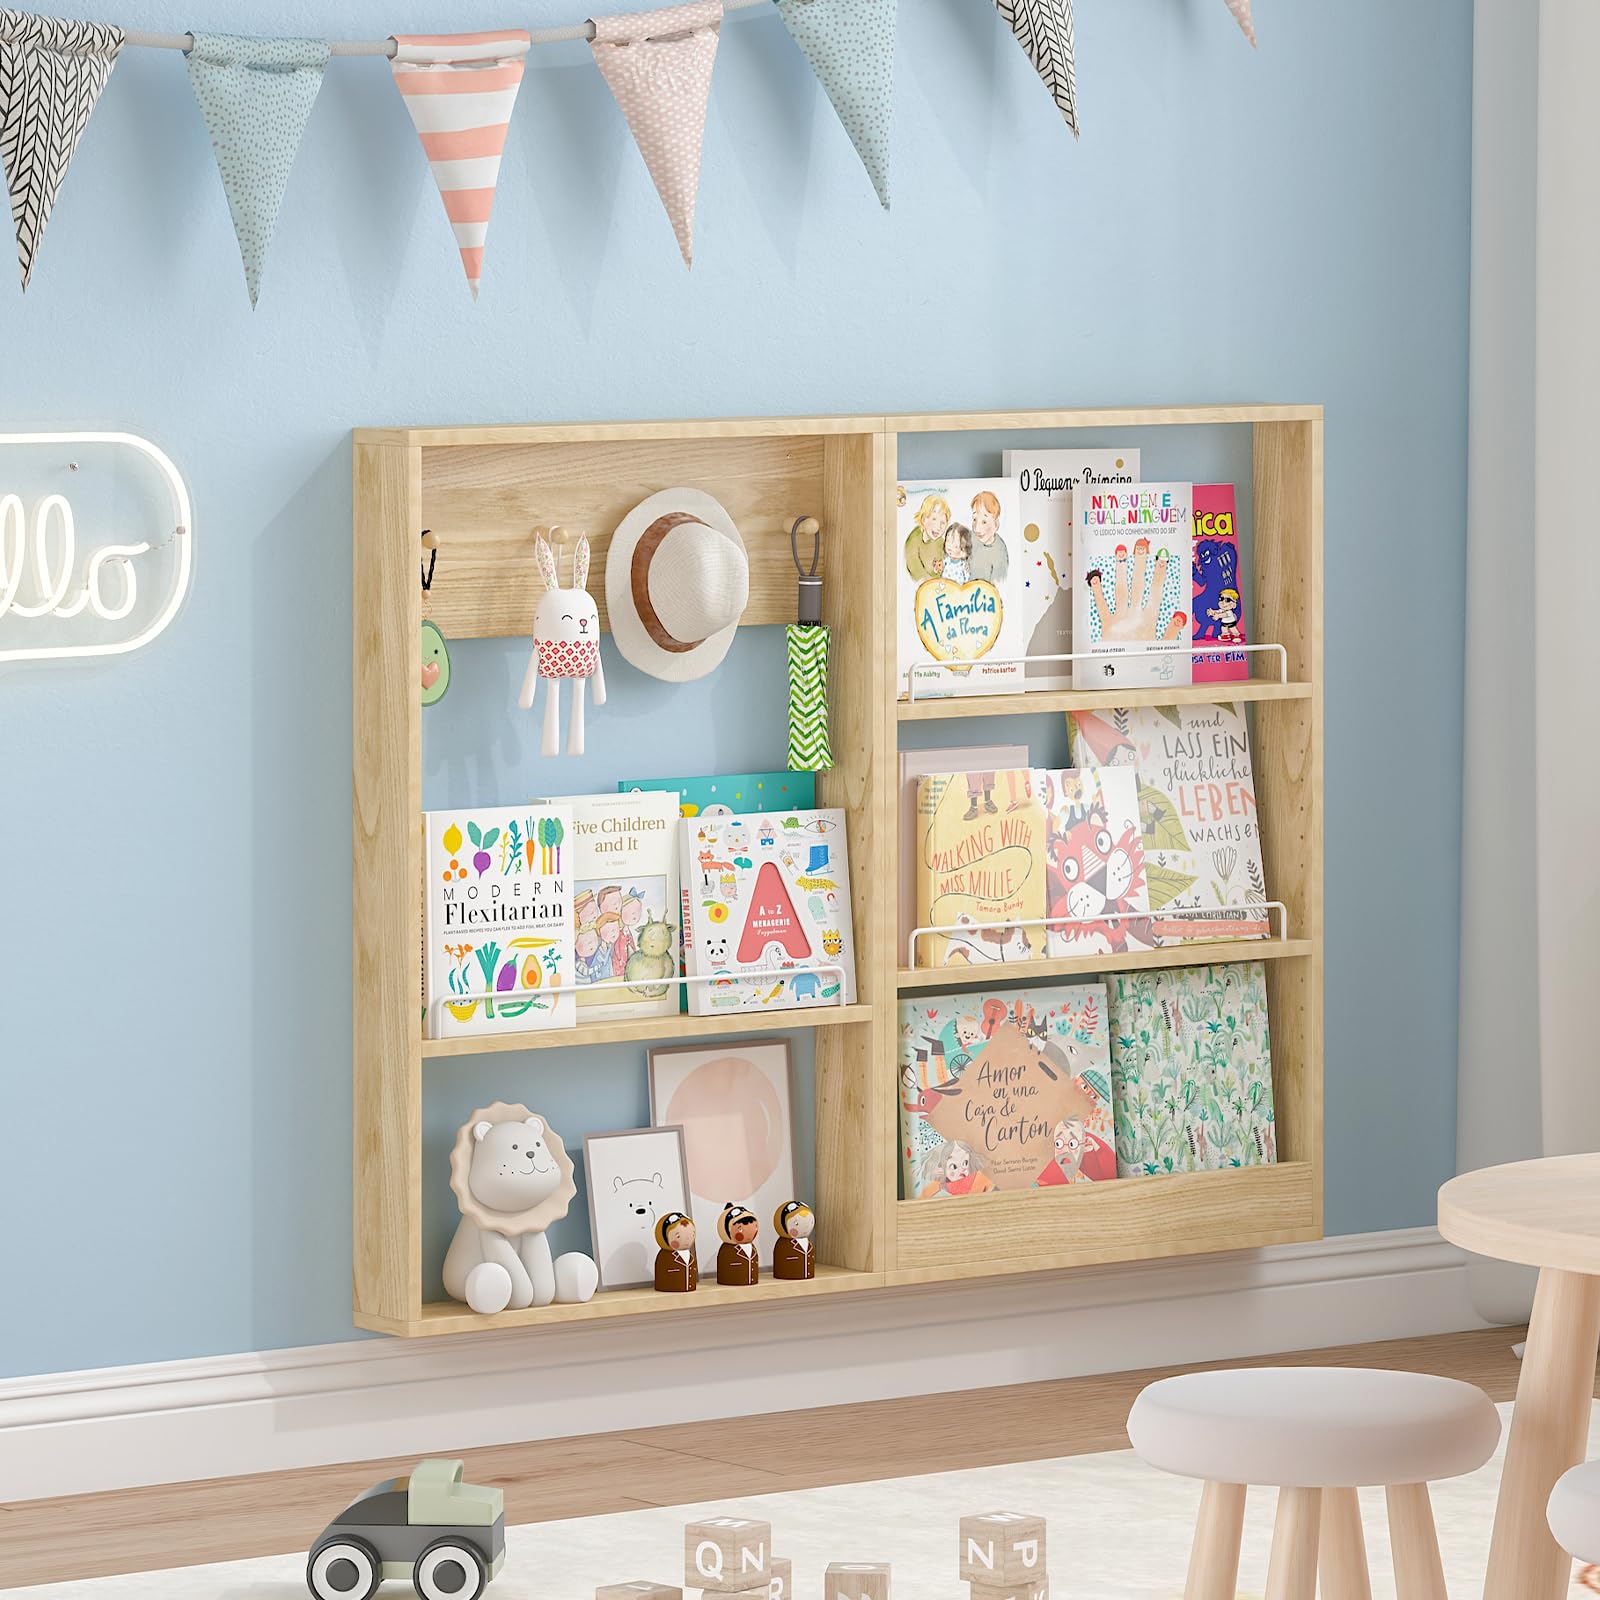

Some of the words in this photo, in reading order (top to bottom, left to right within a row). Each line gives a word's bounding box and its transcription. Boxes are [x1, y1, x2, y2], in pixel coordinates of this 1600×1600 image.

[1020, 469, 1031, 492] O
[1162, 490, 1171, 507] É
[1083, 510, 1120, 525] IGUAL
[1121, 516, 1127, 525] a
[921, 608, 939, 642] A
[946, 626, 957, 640] da
[960, 617, 988, 637] Flora
[1187, 711, 1224, 729] und
[1163, 732, 1202, 759] LASS
[601, 817, 665, 833] Children
[595, 837, 623, 852] and
[628, 837, 638, 850] It
[931, 825, 994, 872] WALKING
[1000, 819, 1033, 847] WITH
[443, 880, 563, 900] MODERN
[940, 873, 966, 895] MISS
[968, 869, 1013, 899] MILLIE
[444, 897, 563, 925] Flexitarian
[682, 889, 692, 949] MENAGERIE
[752, 918, 791, 928] MENAGERIE
[760, 905, 766, 916] A
[776, 904, 782, 914] Z
[977, 1060, 1027, 1088] Amor
[993, 1087, 1008, 1099] en
[1013, 1085, 1039, 1097] una
[965, 1100, 996, 1126] Caja
[1000, 1099, 1016, 1117] de
[985, 1115, 1054, 1151] Cartón
[695, 1540, 724, 1581] Q
[742, 1542, 764, 1574] N
[967, 1538, 994, 1570] N
[1013, 1539, 1038, 1568] P
[768, 1576, 784, 1600] R
